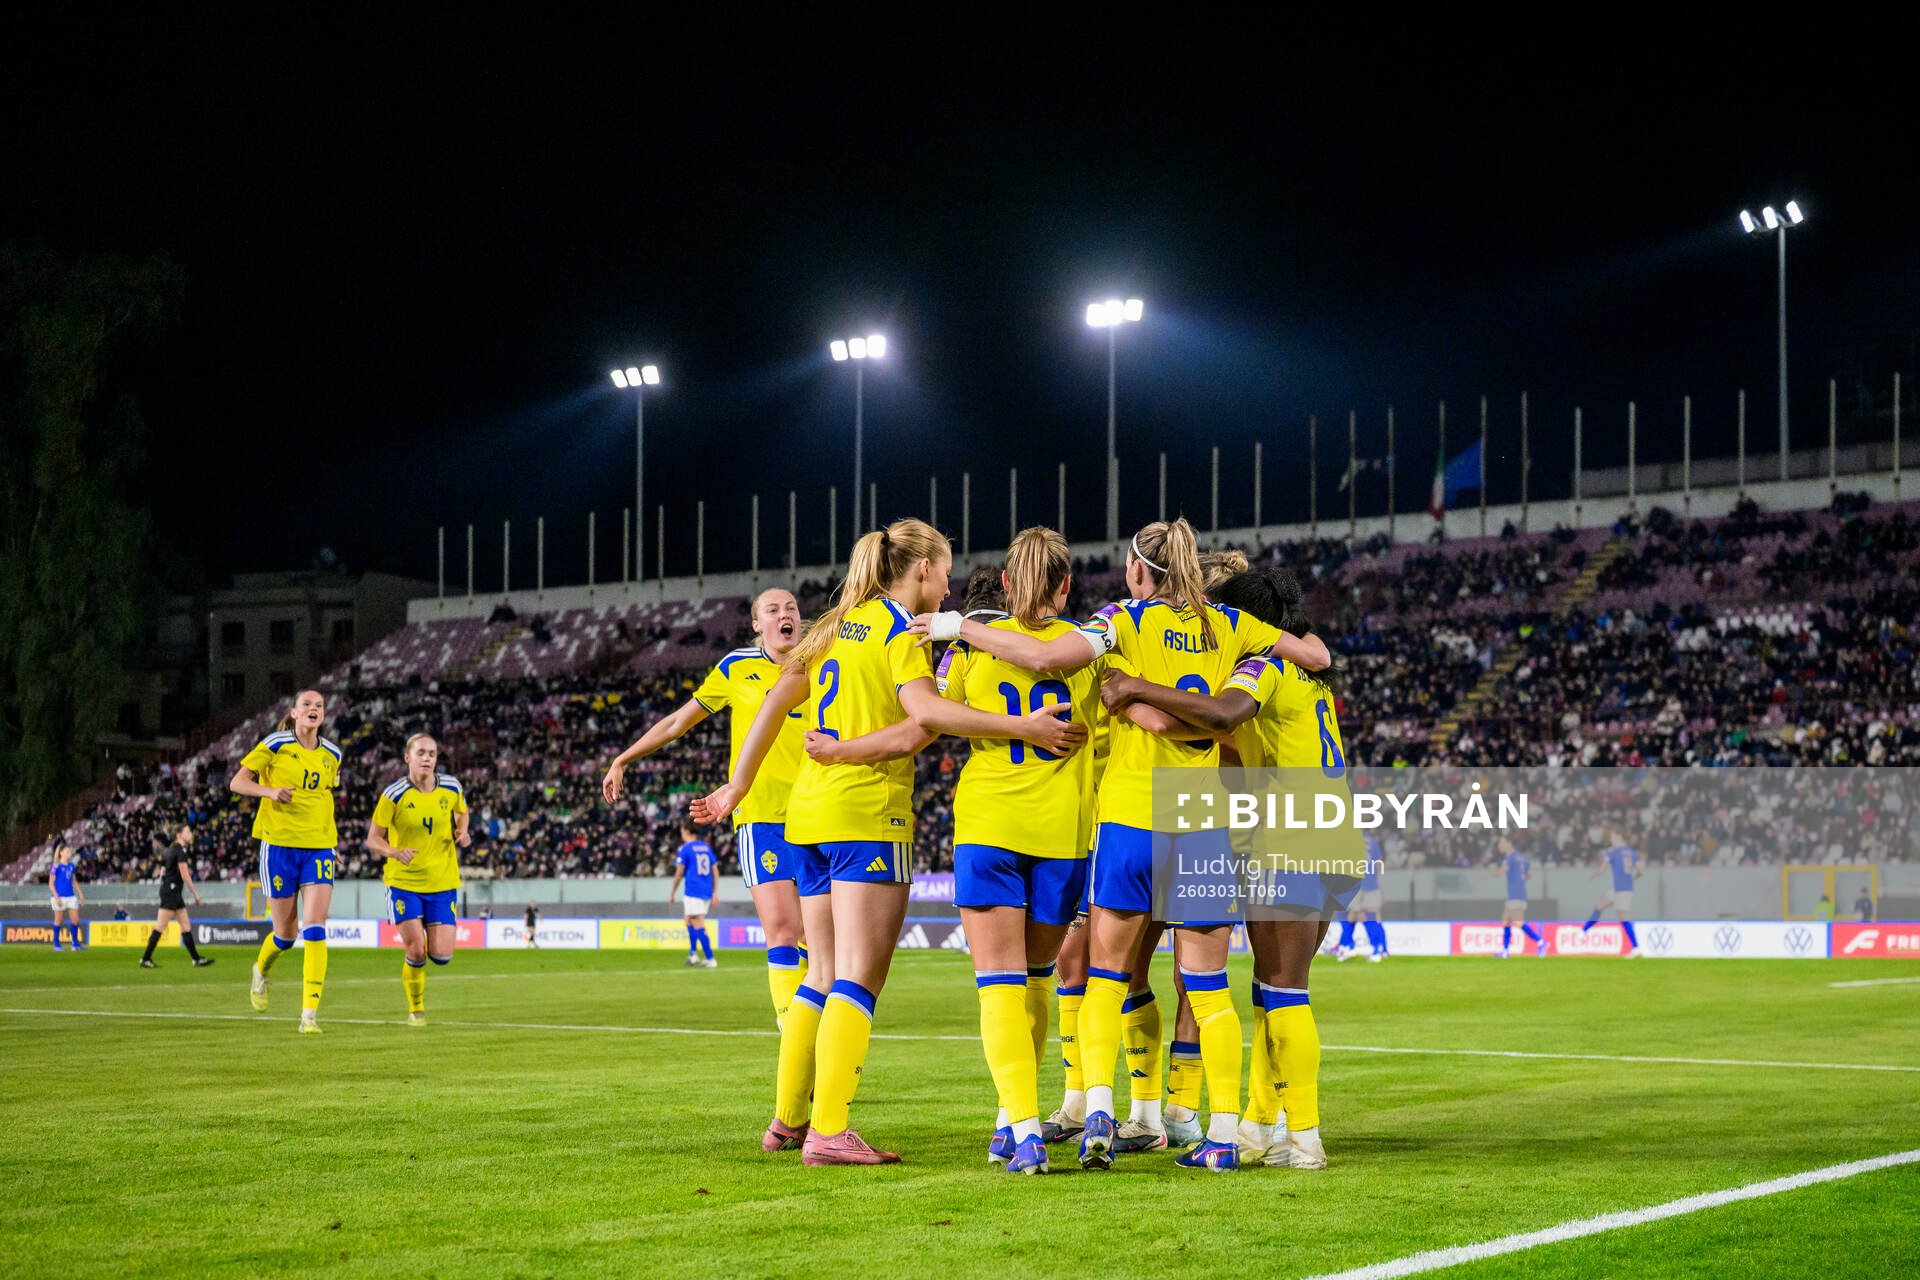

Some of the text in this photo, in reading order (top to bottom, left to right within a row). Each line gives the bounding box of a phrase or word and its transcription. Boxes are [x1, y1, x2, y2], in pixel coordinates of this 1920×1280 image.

[1163, 628, 1219, 653] ASLLA
[818, 658, 840, 741] 2
[1315, 698, 1346, 779] 6
[302, 768, 321, 790] 13
[422, 816, 433, 835] 4
[315, 858, 333, 880] 13
[212, 928, 259, 942] TeamSystem
[326, 926, 361, 940] UNGA
[502, 926, 585, 941] PRMETEON
[635, 925, 688, 942] Telepas
